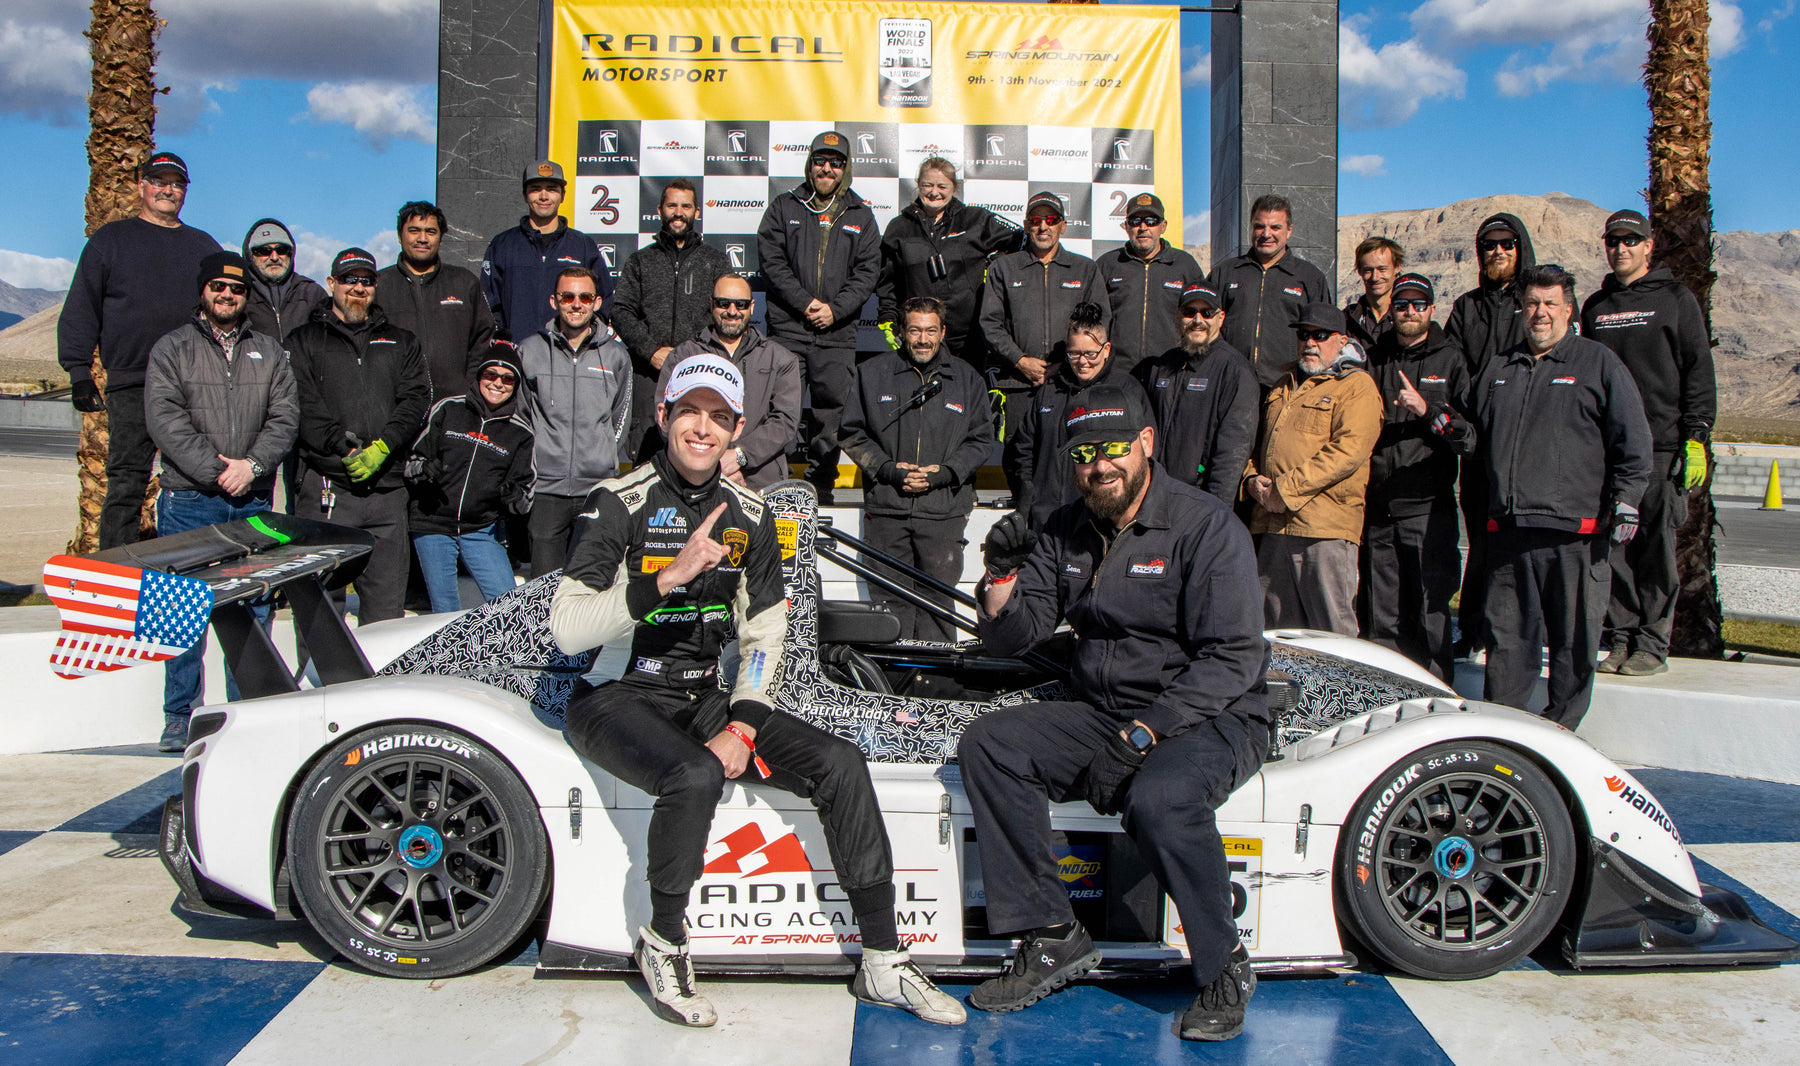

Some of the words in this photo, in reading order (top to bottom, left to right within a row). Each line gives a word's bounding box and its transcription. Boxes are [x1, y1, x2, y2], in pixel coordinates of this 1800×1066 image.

[886, 29, 926, 38] WORLD
[581, 33, 844, 55] RADICAL
[887, 38, 925, 47] FINALS
[965, 50, 1030, 60] SPRING
[1032, 52, 1119, 62] MOUNTAIN
[582, 67, 728, 83] MOTORSPORT
[967, 75, 986, 85] 9th
[1000, 76, 1024, 86] 13th
[1028, 76, 1088, 87] November
[1093, 78, 1122, 88] 2022
[783, 144, 812, 152] HANK
[965, 159, 1025, 167] RADICAL
[1094, 162, 1152, 171] RADICAL
[590, 184, 620, 226] 25
[1109, 190, 1128, 217] 2
[1086, 410, 1125, 420] MOUNTAIN
[624, 493, 641, 505] OMP
[741, 501, 761, 514] OMP
[1065, 564, 1081, 574] Sean
[654, 614, 671, 623] VF
[636, 660, 662, 672] OMP
[683, 670, 705, 679] LIDDY
[765, 661, 784, 698] ROGER
[801, 703, 850, 718] Patrick
[854, 708, 890, 721] Liddy
[1619, 785, 1684, 851] HANKOO
[700, 882, 938, 905] ADICL
[1069, 889, 1103, 899] FUELS
[787, 910, 938, 927] ACAMY
[732, 935, 755, 945] AT
[760, 934, 835, 945] SPRING
[837, 932, 938, 945] MOTAIN
[650, 954, 665, 994] sparco
